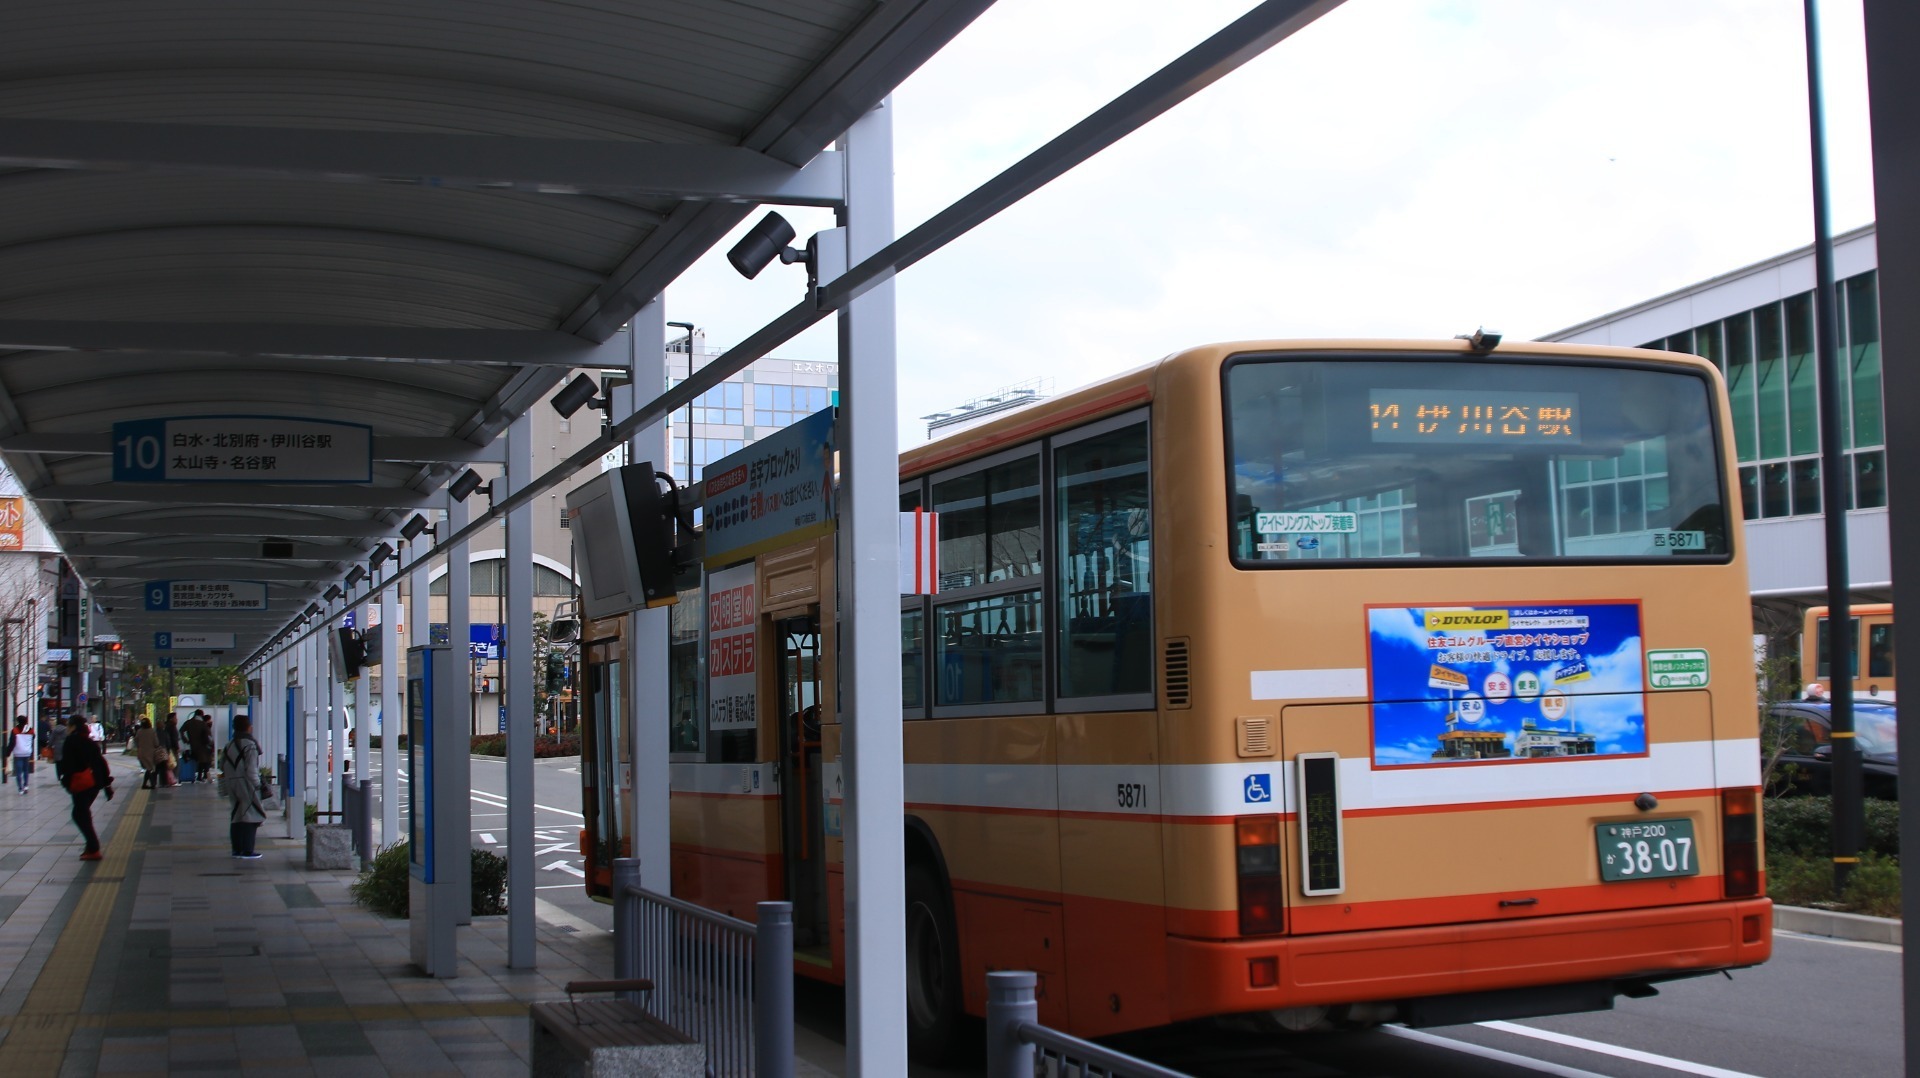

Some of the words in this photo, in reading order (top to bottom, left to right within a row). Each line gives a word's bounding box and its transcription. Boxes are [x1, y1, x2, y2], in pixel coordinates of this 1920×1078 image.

[794, 362, 838, 373] エスポワ
[1416, 404, 1572, 435] 伊川谷駅
[173, 433, 332, 449] 白水・北別府・伊川谷駅
[118, 435, 160, 469] 10
[173, 455, 277, 470] 太山寺・名谷駅
[1259, 514, 1355, 531] アイドリングストップ装着車
[1654, 533, 1666, 547] 西
[1669, 532, 1699, 547] 5871
[152, 588, 164, 605] 9
[711, 590, 753, 628] 文明堂の
[1443, 615, 1503, 626] DUNLOP
[159, 635, 168, 646] 8
[1427, 632, 1589, 649] 住友ゴムグループ直営タイヤショップ
[711, 638, 753, 672] カステラ
[1488, 681, 1508, 691] 安全
[1517, 680, 1537, 690] 便利
[1461, 700, 1482, 711] 安心
[1117, 783, 1147, 808] 5871
[1621, 824, 1666, 839] 神戸200
[1617, 837, 1692, 875] 38-07
